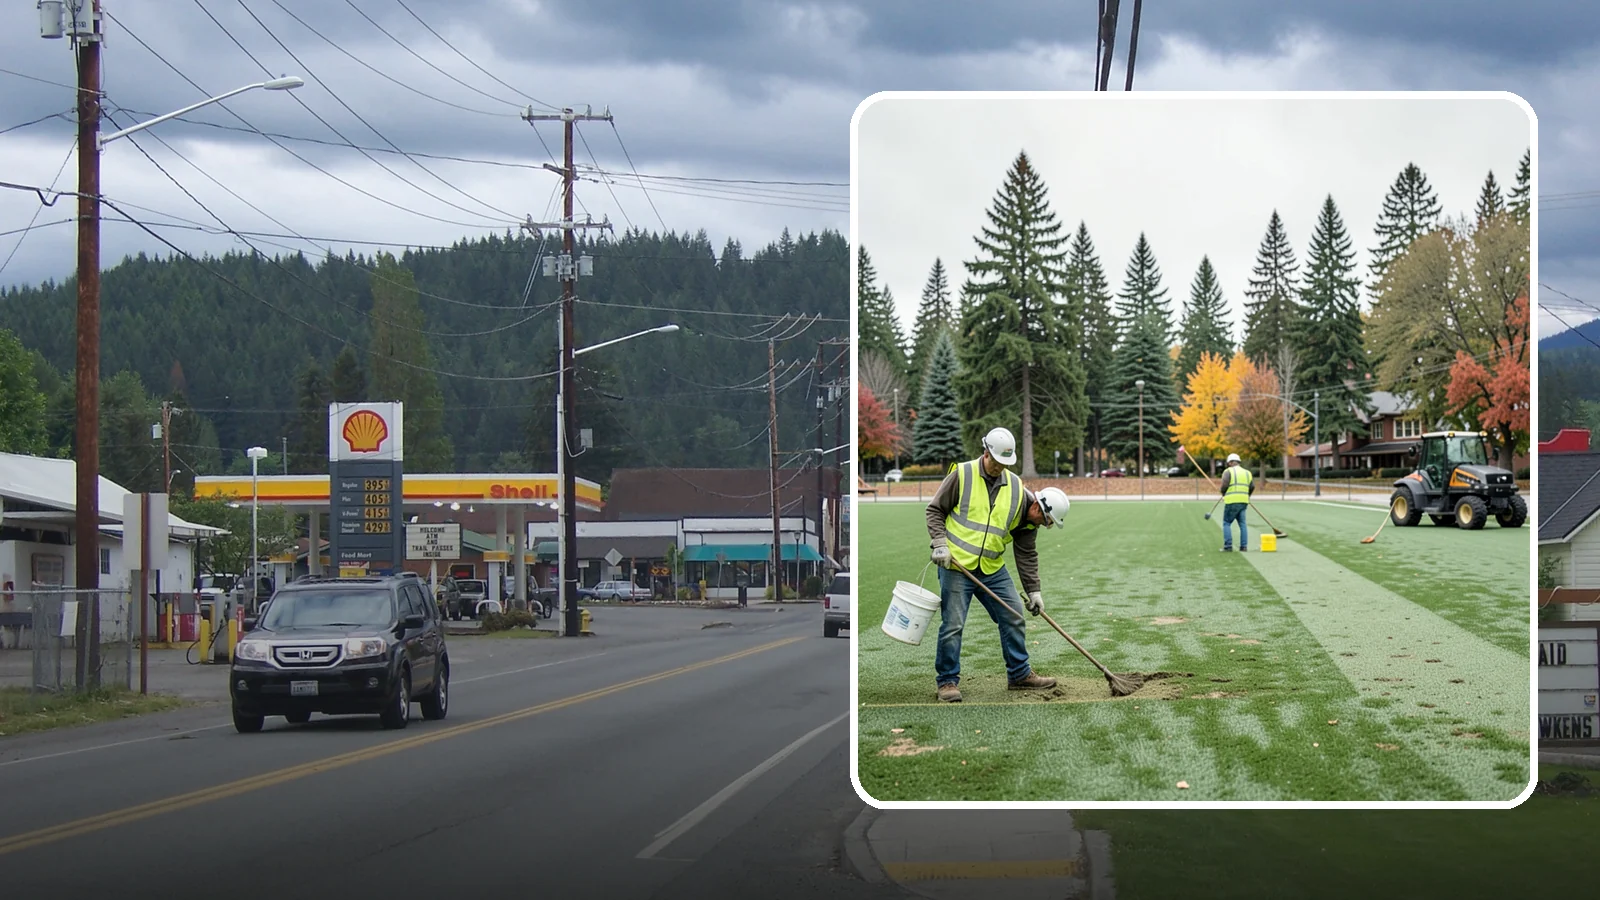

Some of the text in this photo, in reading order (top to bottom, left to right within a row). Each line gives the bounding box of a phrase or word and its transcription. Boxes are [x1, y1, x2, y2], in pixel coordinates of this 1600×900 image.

[366, 480, 384, 490] 395
[490, 484, 547, 499] Shell
[366, 494, 384, 504] 405
[366, 508, 384, 518] 415
[366, 522, 384, 532] 429
